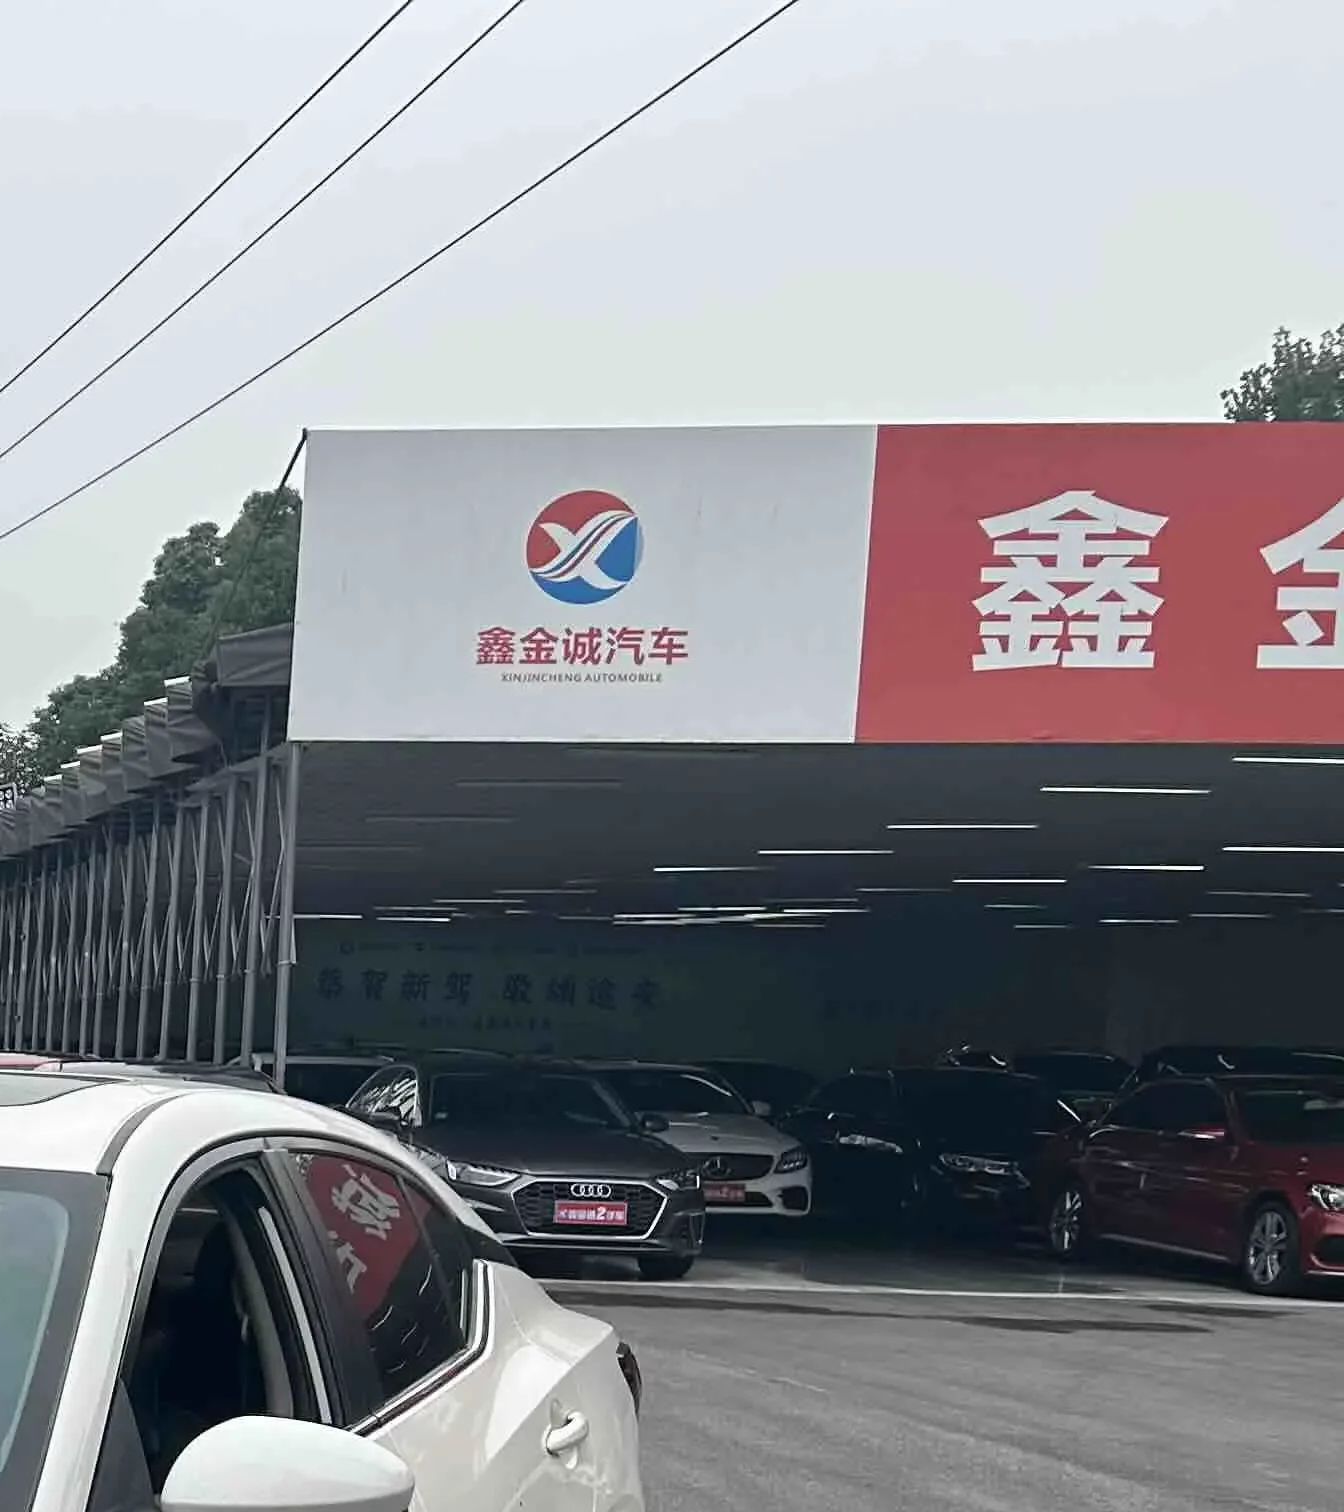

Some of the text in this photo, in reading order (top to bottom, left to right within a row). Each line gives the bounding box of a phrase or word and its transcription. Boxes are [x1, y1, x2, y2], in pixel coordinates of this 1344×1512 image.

[475, 626, 690, 667] 鑫金诚汽车
[501, 671, 663, 684] XINJINCHENG AUTOMOBILE
